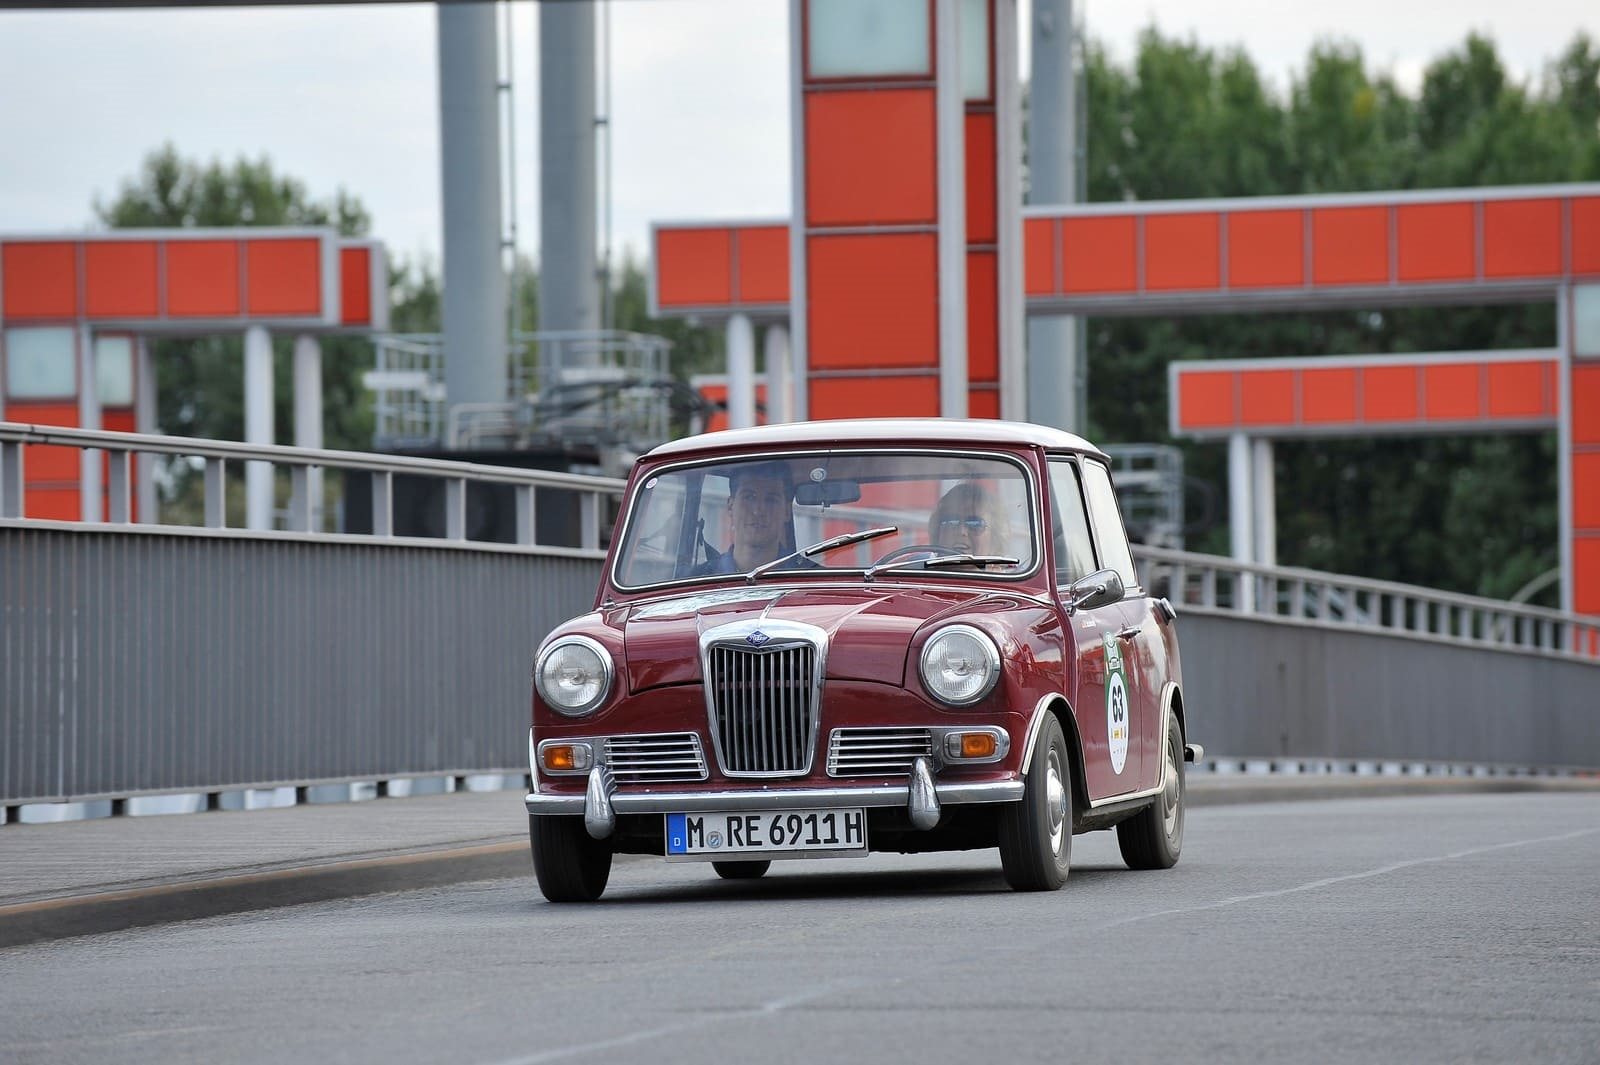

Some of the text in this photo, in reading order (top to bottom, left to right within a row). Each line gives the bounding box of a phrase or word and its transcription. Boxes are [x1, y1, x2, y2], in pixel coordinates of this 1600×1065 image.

[1112, 685, 1124, 723] 63
[673, 837, 681, 847] D
[687, 816, 705, 848] M
[726, 815, 763, 847] RE
